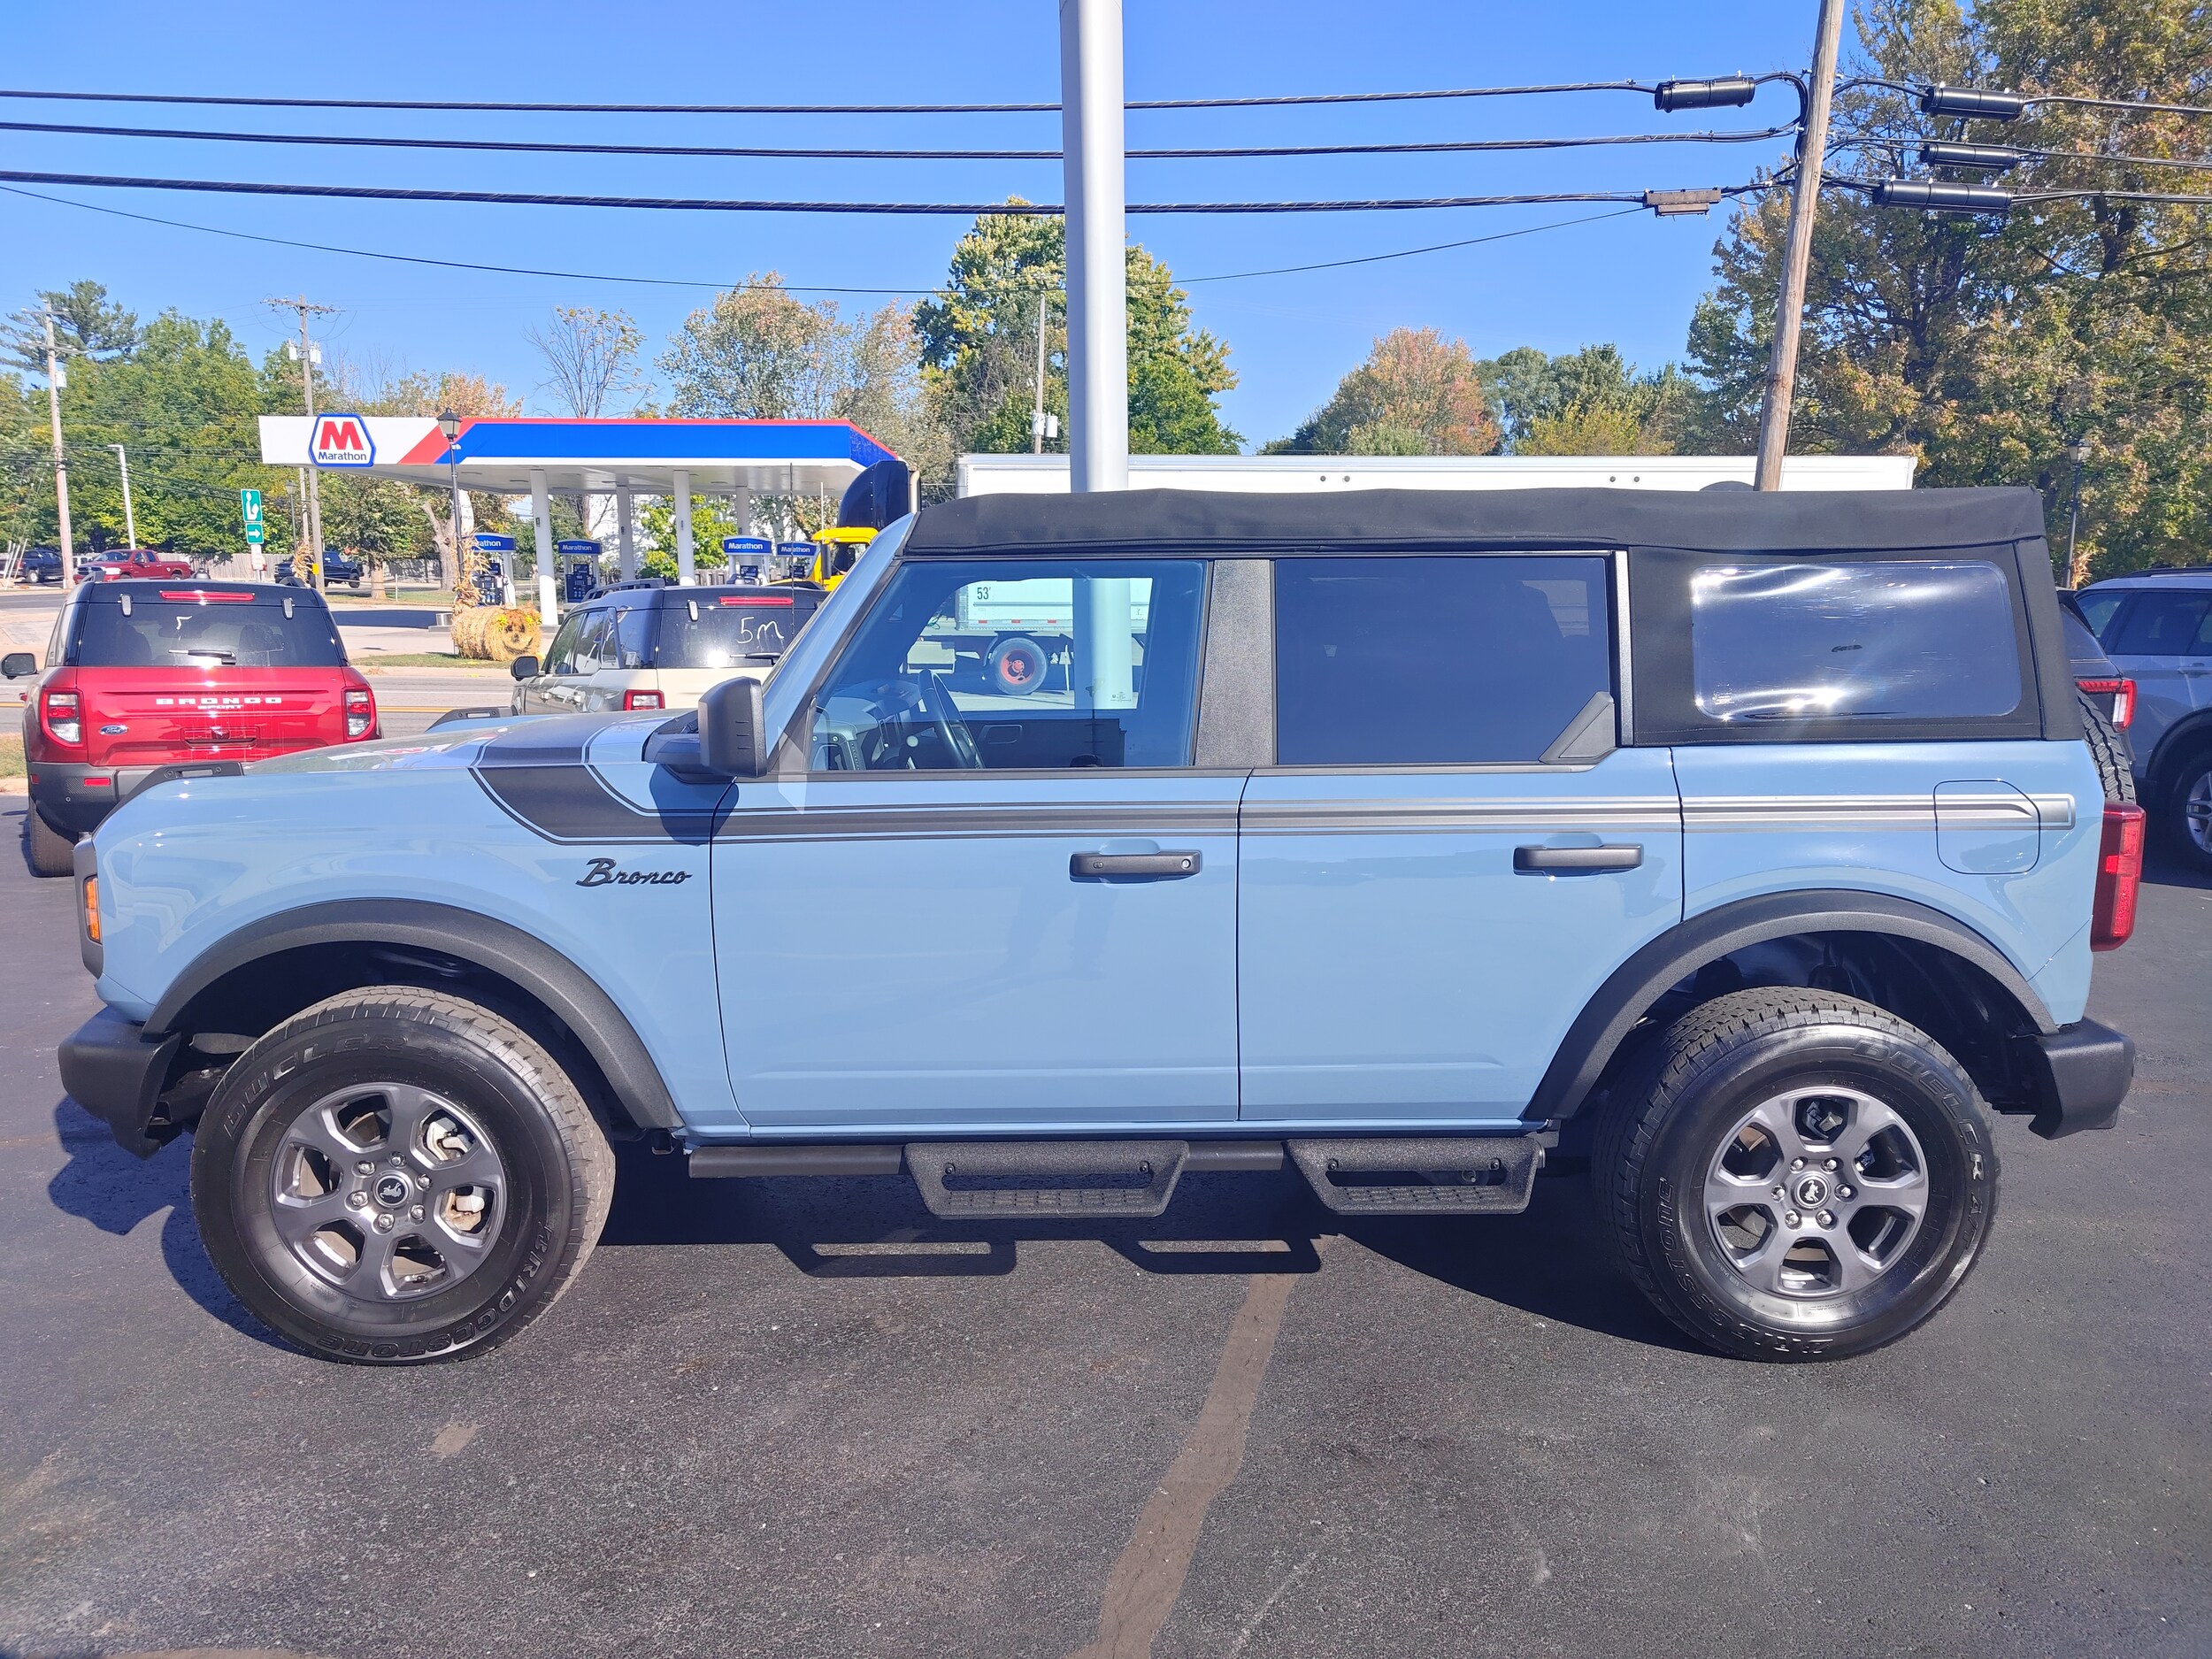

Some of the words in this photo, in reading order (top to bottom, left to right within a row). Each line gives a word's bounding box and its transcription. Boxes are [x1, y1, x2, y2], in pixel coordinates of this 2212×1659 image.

[319, 421, 364, 449] M
[576, 857, 693, 887] Bronco
[223, 1033, 410, 1140] DUELER
[1853, 1039, 1985, 1182] DUELER
